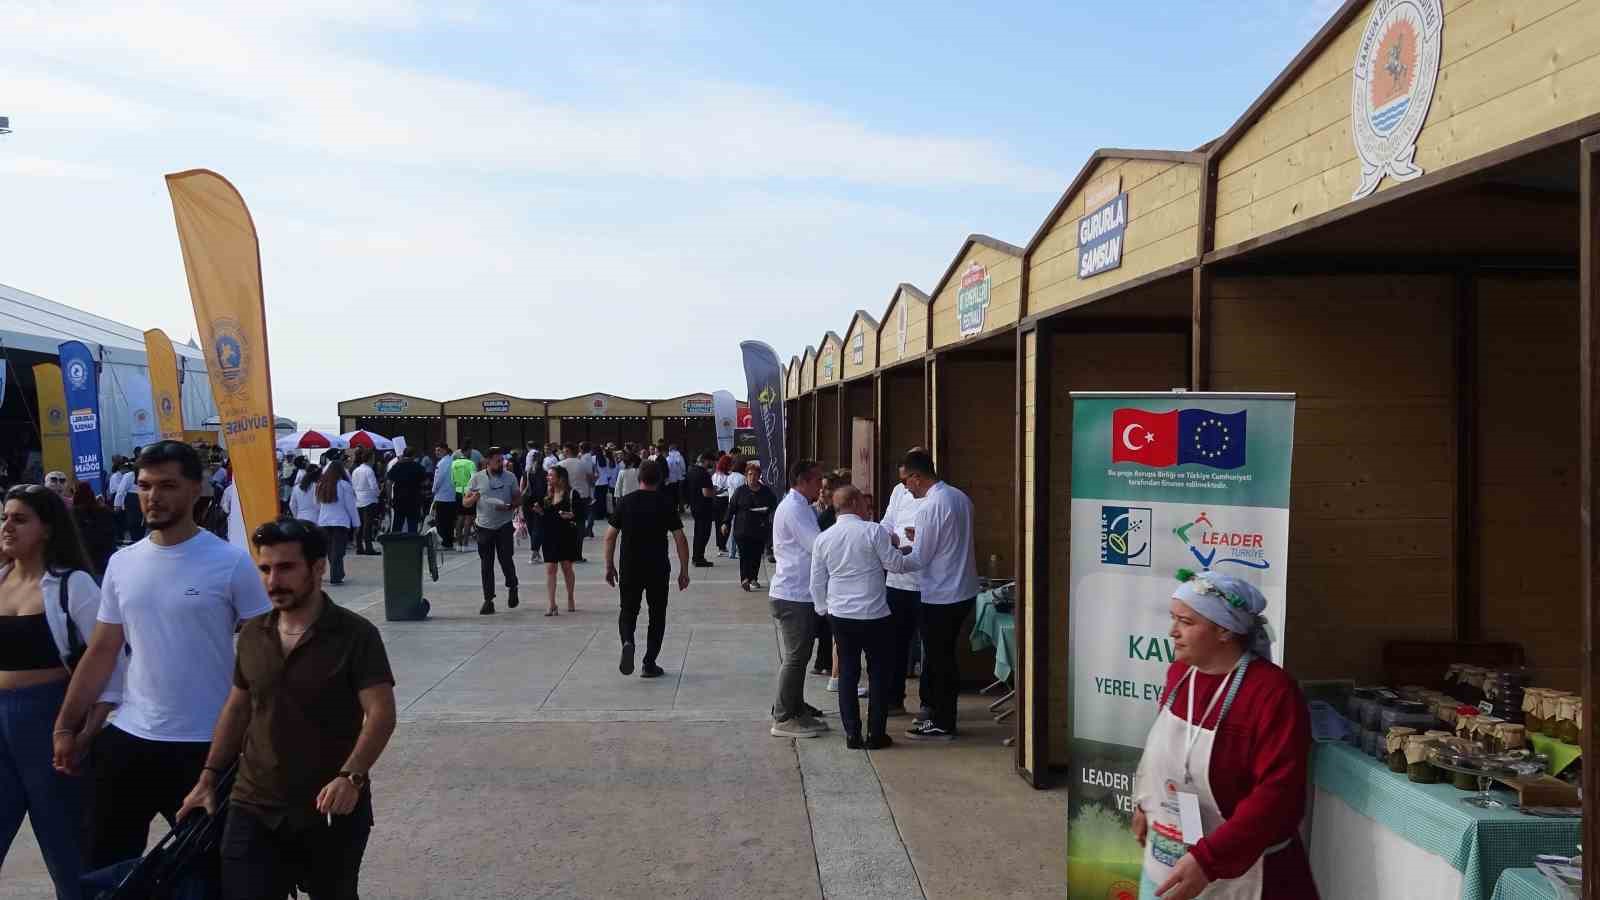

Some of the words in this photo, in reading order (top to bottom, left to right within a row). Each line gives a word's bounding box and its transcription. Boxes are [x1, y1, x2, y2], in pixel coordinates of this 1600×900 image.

[1080, 200, 1124, 246] GURURLA
[1080, 237, 1120, 277] SAMSUN
[1128, 479, 1160, 487] tarafından
[1135, 470, 1156, 479] Avrupa
[1186, 472, 1210, 481] Türkiye
[1211, 473, 1252, 482] Cumhuriyeti
[1202, 531, 1263, 548] LEADER
[1129, 635, 1176, 663] KAV
[1095, 677, 1139, 699] YEREL
[1143, 684, 1162, 701] EY
[1082, 767, 1129, 791] LEADER
